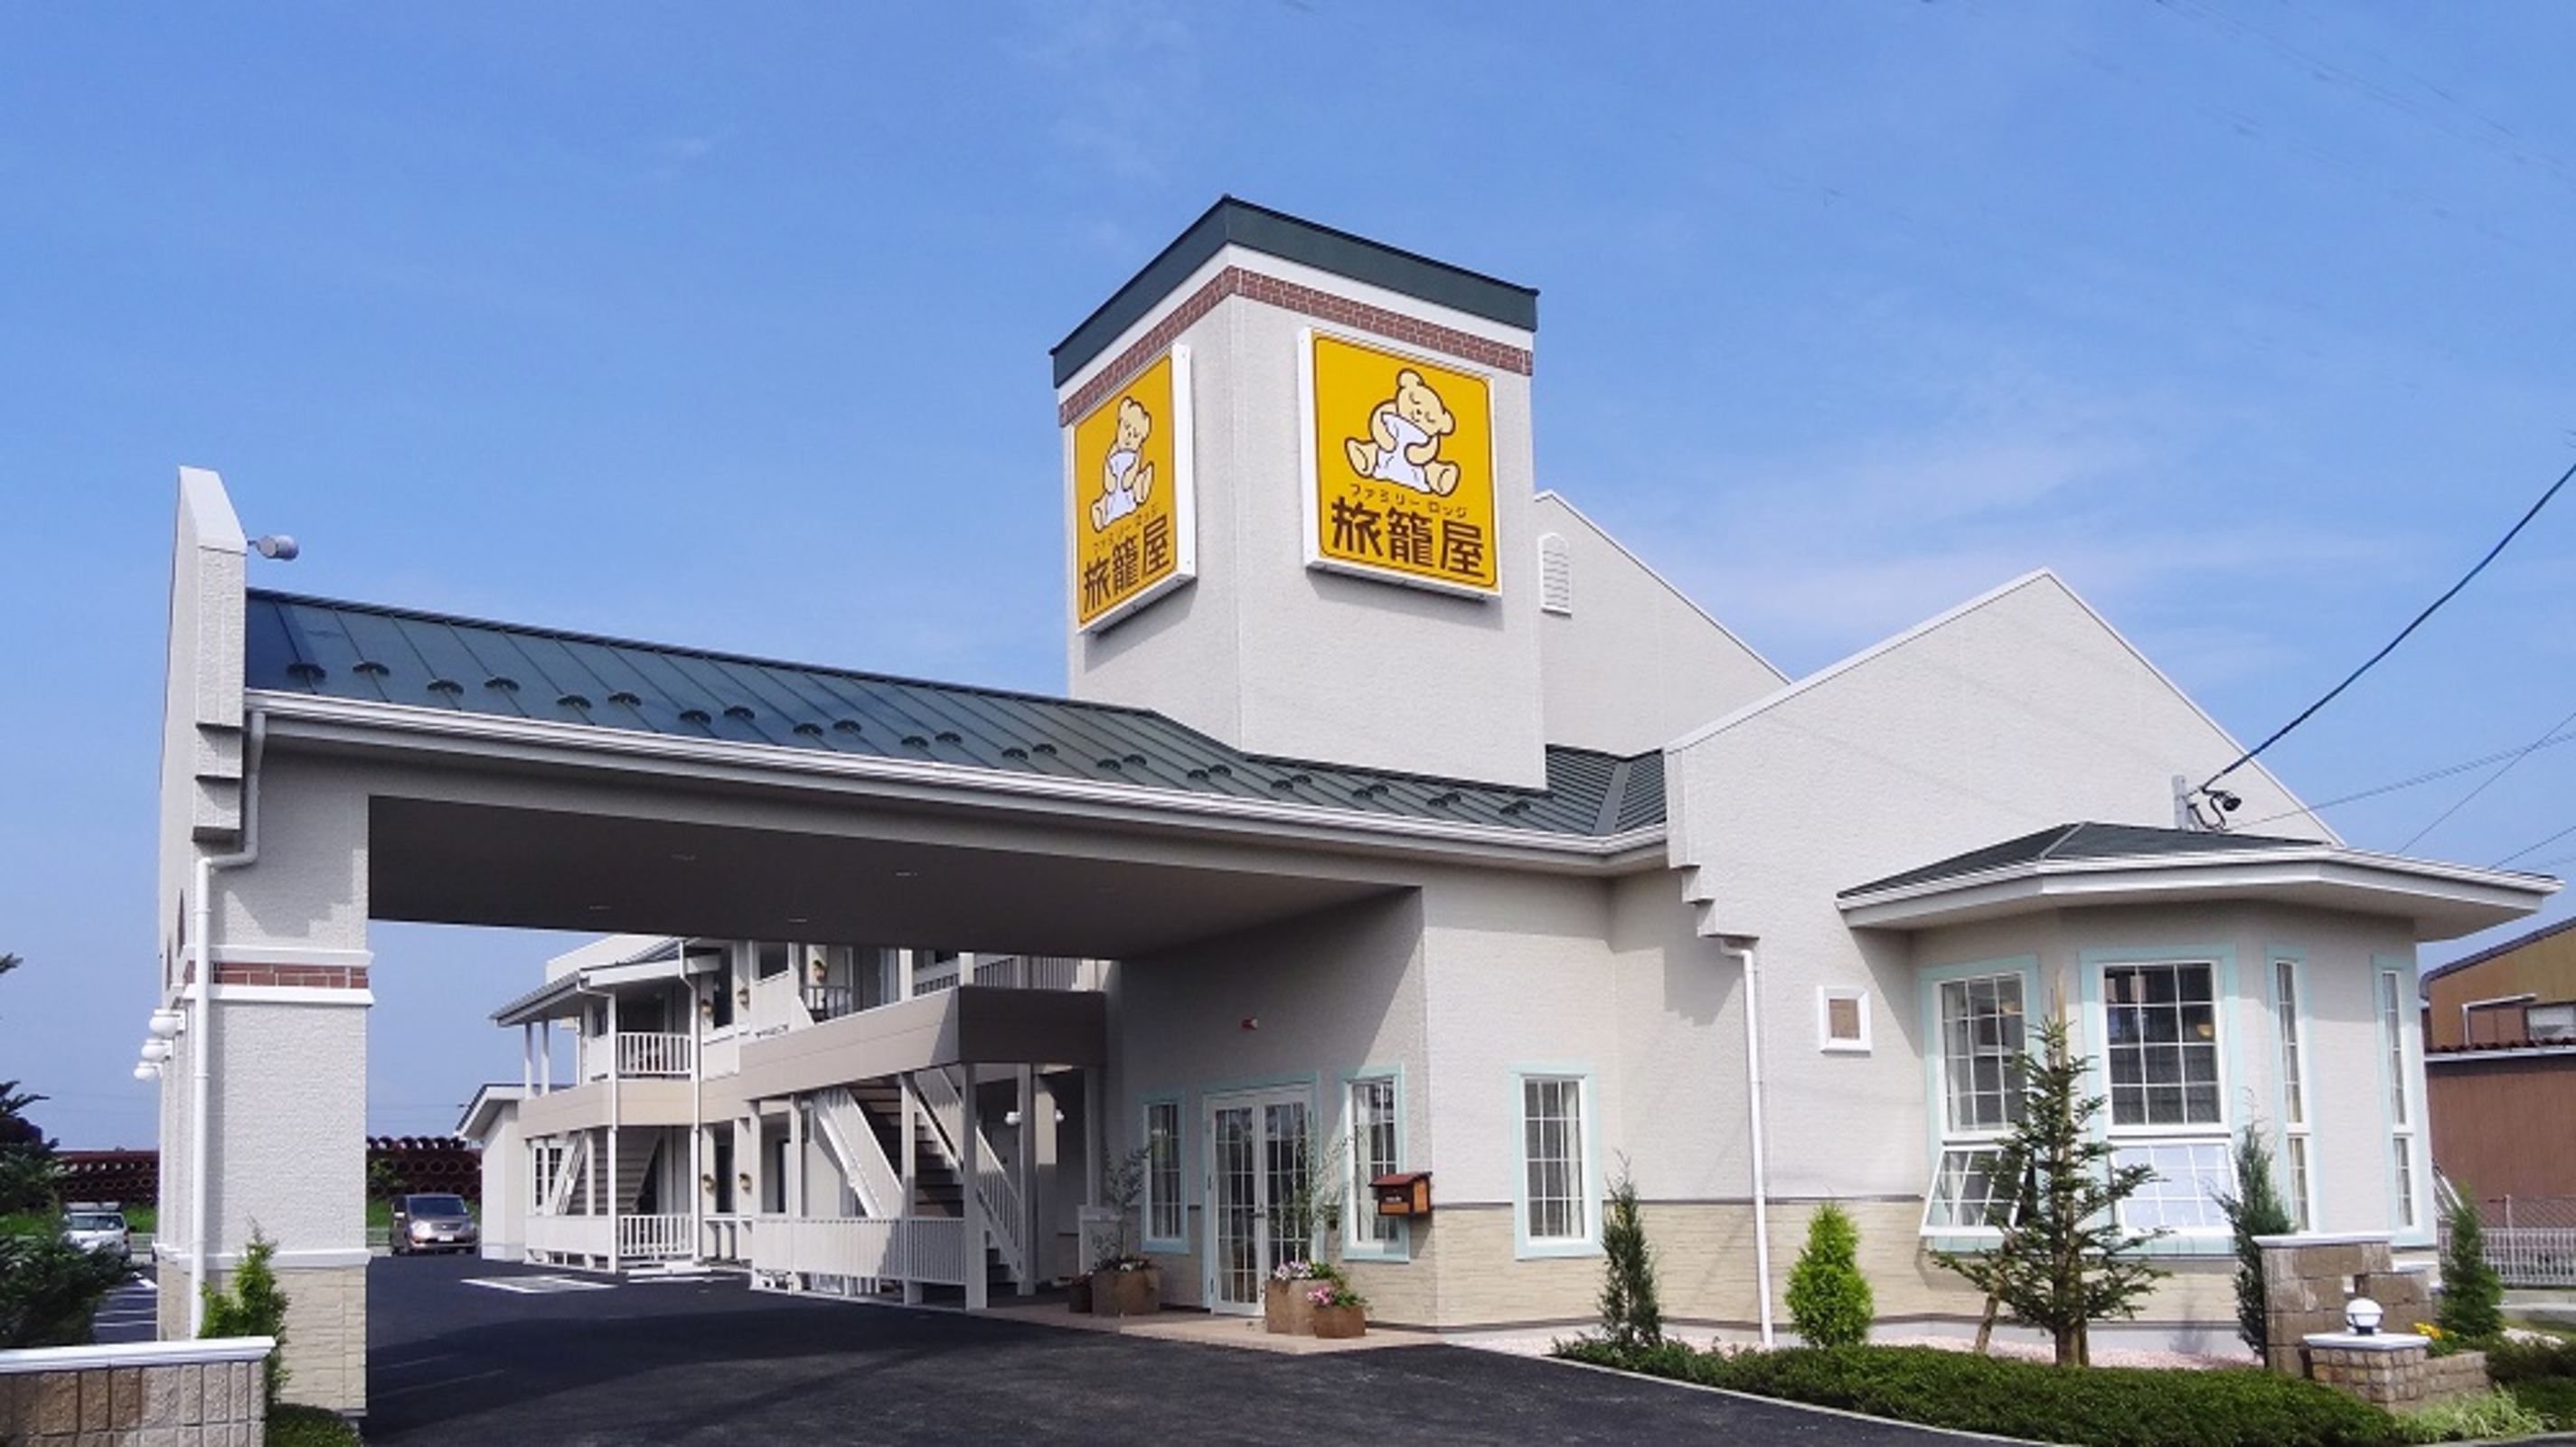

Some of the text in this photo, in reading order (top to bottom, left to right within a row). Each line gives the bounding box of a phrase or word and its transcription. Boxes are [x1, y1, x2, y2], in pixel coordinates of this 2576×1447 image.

[1084, 512, 1170, 614] 旅籠屋
[1331, 496, 1485, 578] 旅籠屋
